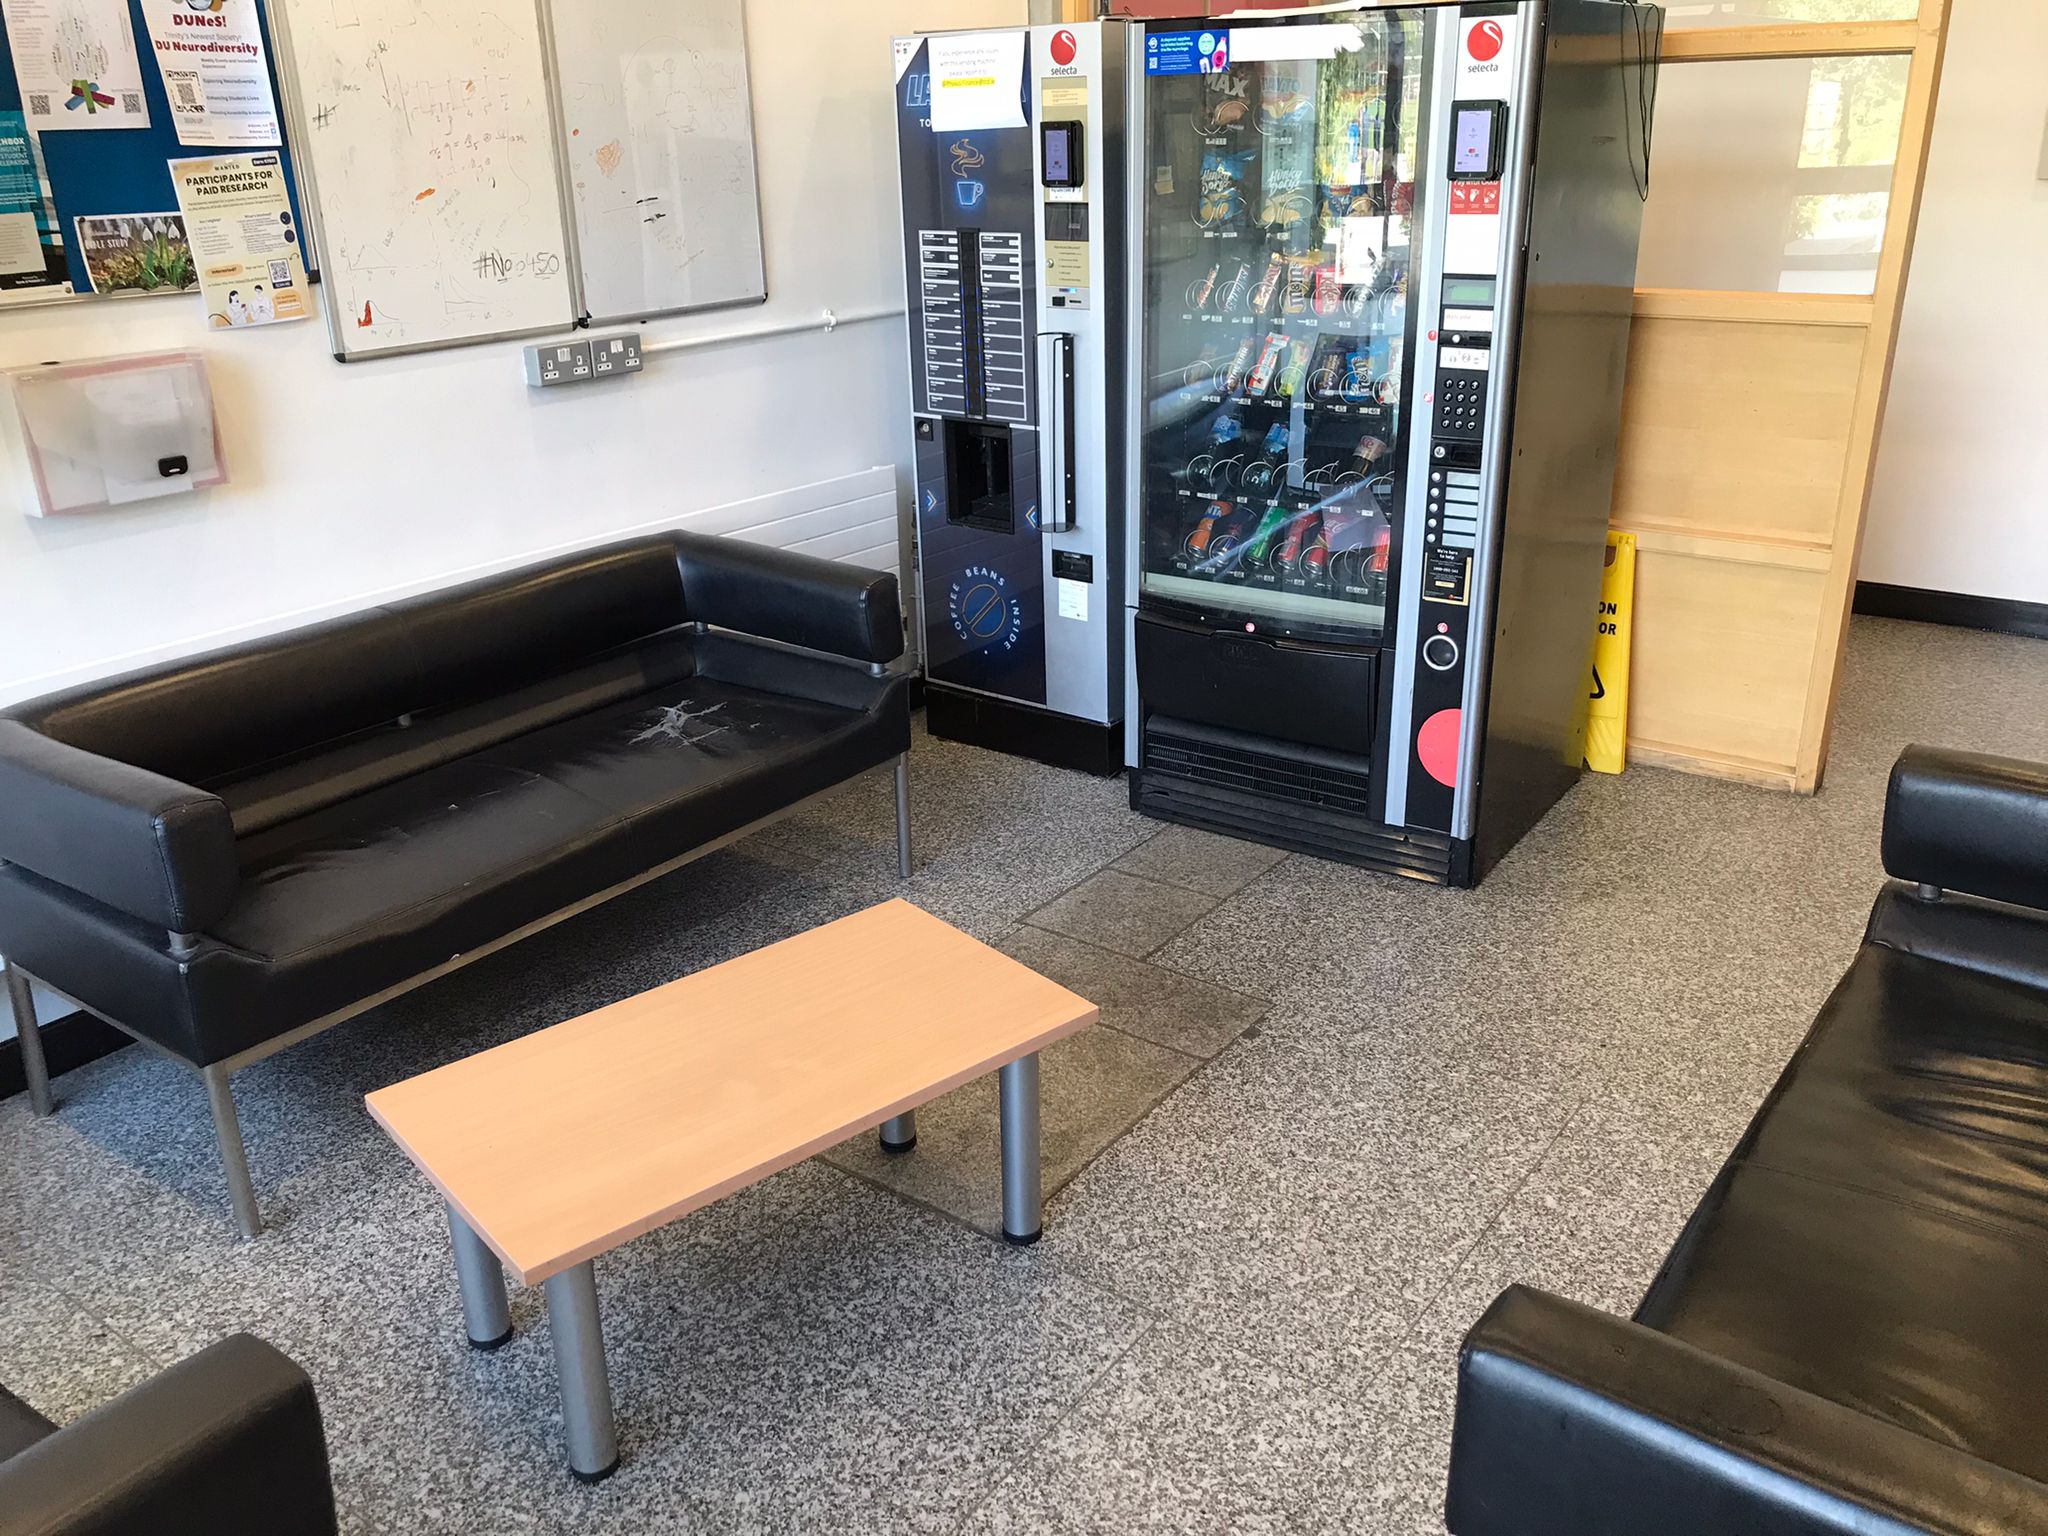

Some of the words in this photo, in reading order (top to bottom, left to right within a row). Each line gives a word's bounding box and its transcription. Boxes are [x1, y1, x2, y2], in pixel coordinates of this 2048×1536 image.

[173, 14, 227, 27] DUNeS!
[155, 40, 170, 50] DU
[173, 42, 258, 56] Neurodiversity
[1050, 66, 1078, 76] selecta
[1468, 64, 1498, 73] selecta
[1205, 74, 1249, 98] MAX
[186, 172, 254, 186] PARTICIPANTS
[254, 170, 273, 180] FOR
[1268, 167, 1303, 183] Hunky
[196, 185, 219, 196] PAID
[220, 182, 268, 194] RESEARCH
[1458, 394, 1464, 402] 5
[965, 566, 1005, 586] BEANS
[950, 583, 968, 640] COFFEE
[1004, 599, 1020, 650] INSIDE
[1599, 622, 1616, 636] OR
